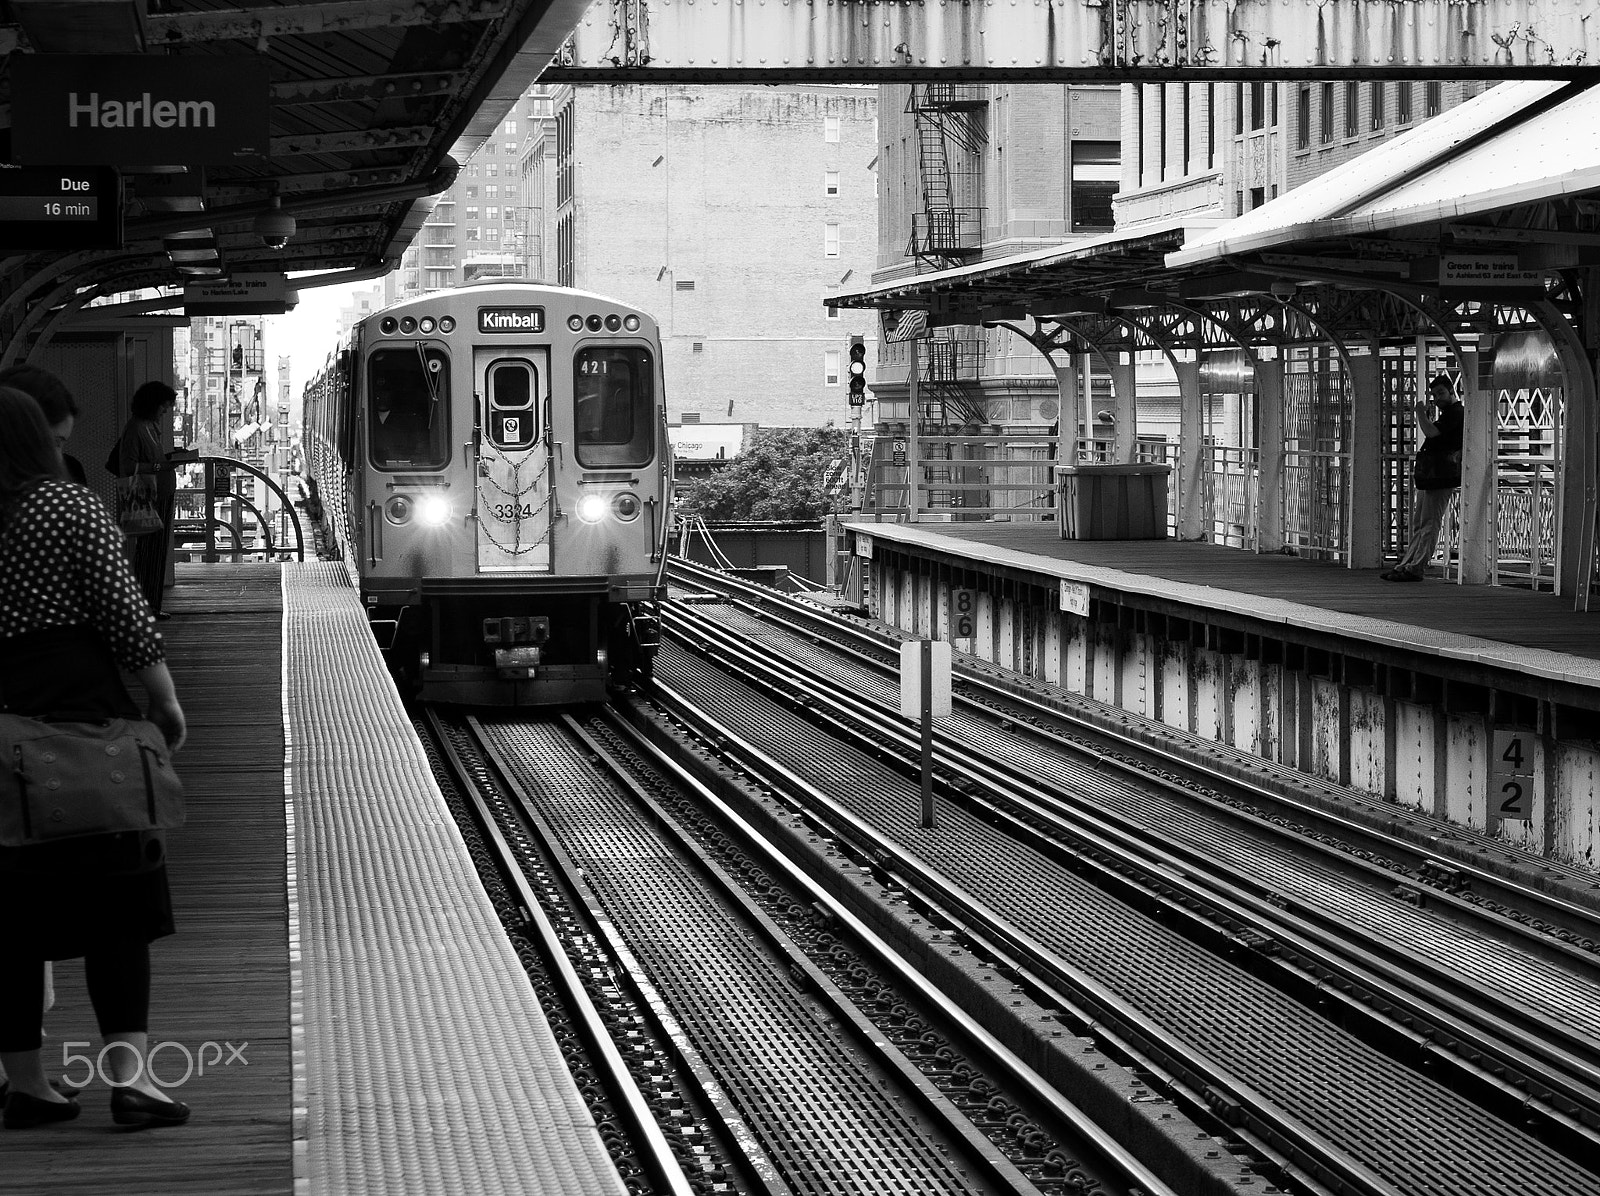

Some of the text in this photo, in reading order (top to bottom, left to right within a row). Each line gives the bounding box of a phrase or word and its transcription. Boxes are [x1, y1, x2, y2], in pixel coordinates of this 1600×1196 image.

[68, 92, 216, 128] Harlem
[60, 178, 90, 190] Due
[43, 203, 90, 215] 16 min
[1447, 261, 1515, 270] Green line trains
[245, 280, 267, 288] trains
[483, 312, 539, 328] Kimball
[581, 360, 607, 374] 421
[677, 441, 703, 450] Chicago
[494, 503, 532, 519] 3324
[957, 591, 972, 613] 8
[958, 615, 973, 637] 6
[1502, 738, 1525, 769] 4
[1500, 781, 1523, 814] 2
